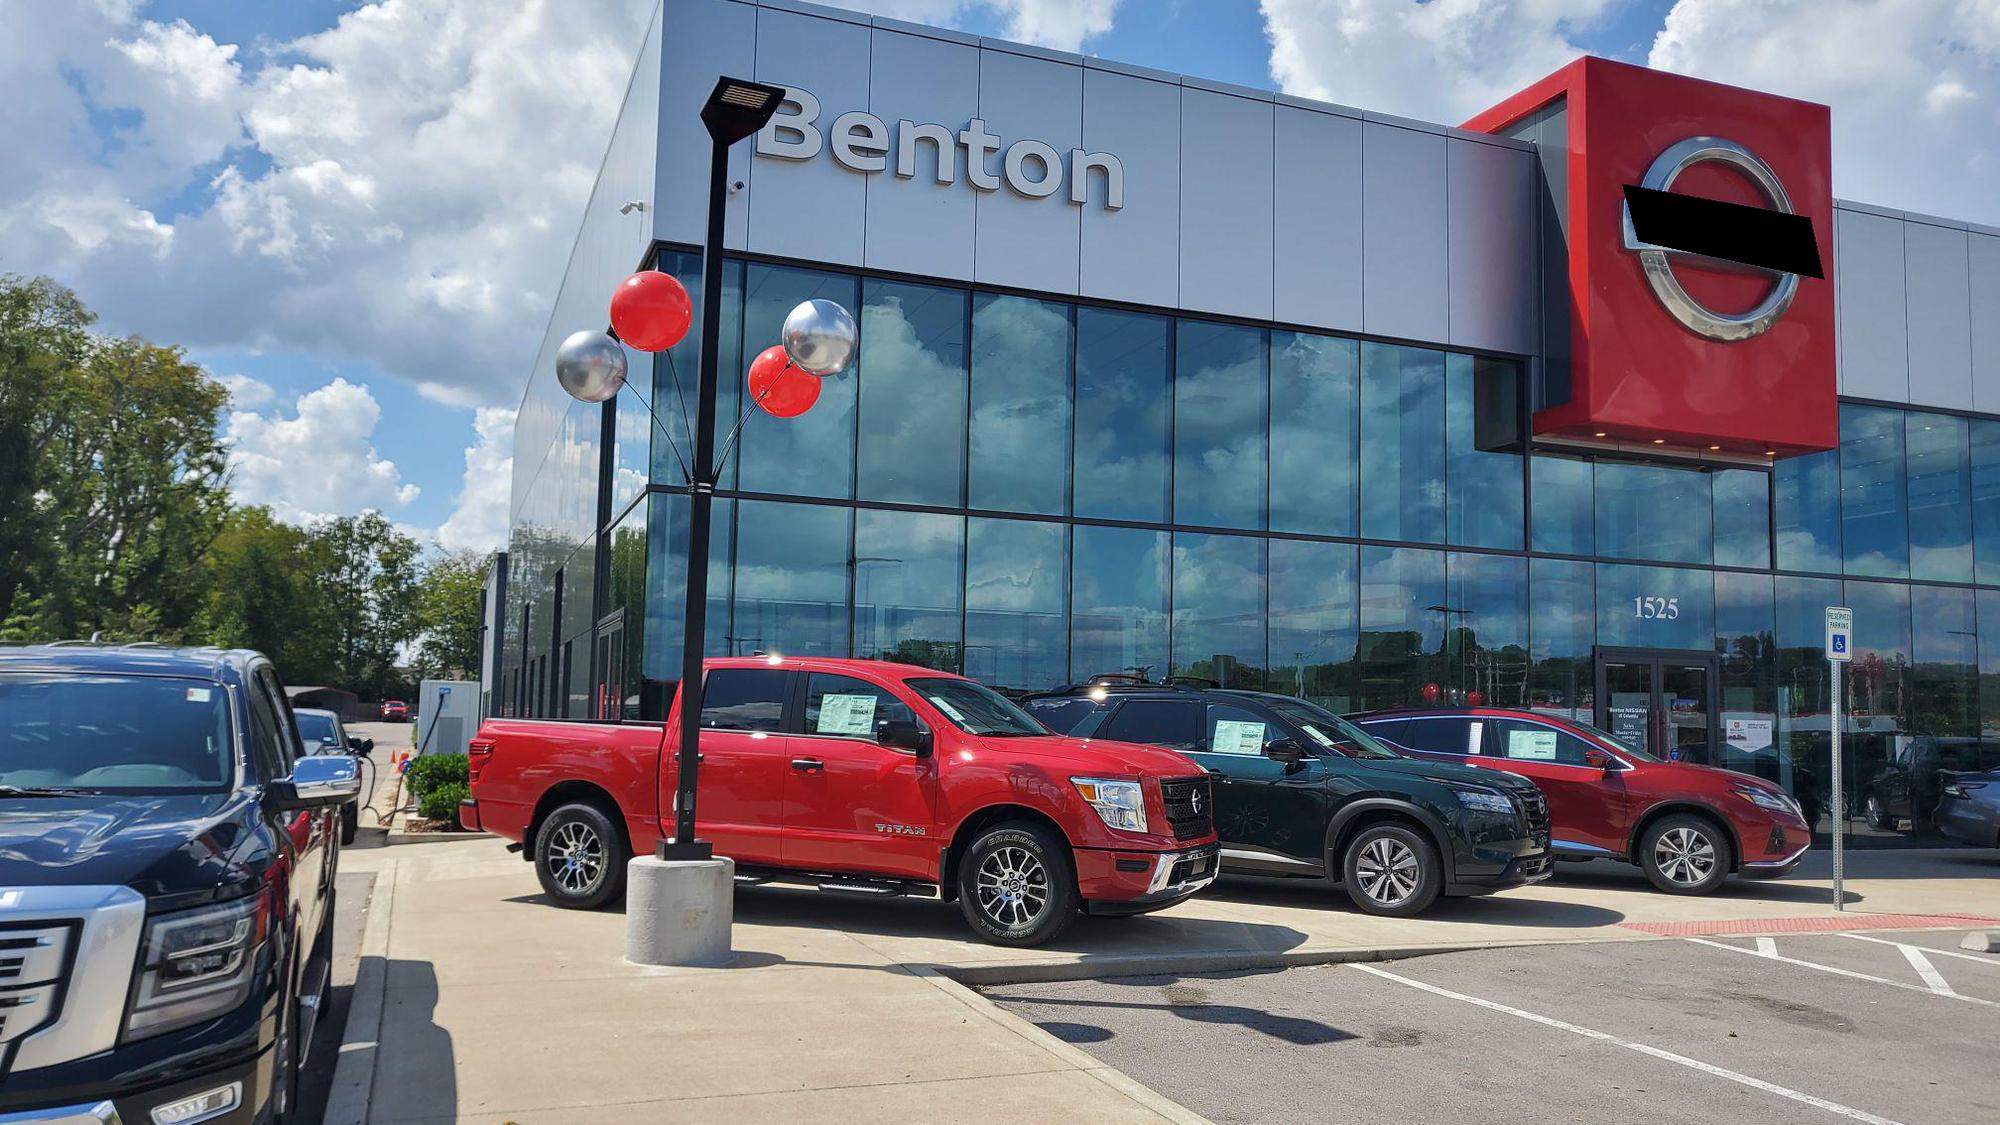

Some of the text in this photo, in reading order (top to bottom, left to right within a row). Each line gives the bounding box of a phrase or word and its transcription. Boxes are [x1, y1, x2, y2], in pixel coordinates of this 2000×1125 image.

[755, 81, 1125, 212] Benton
[1634, 596, 1679, 619] 1525
[1829, 621, 1849, 629] PARKING
[875, 823, 926, 835] TITAN
